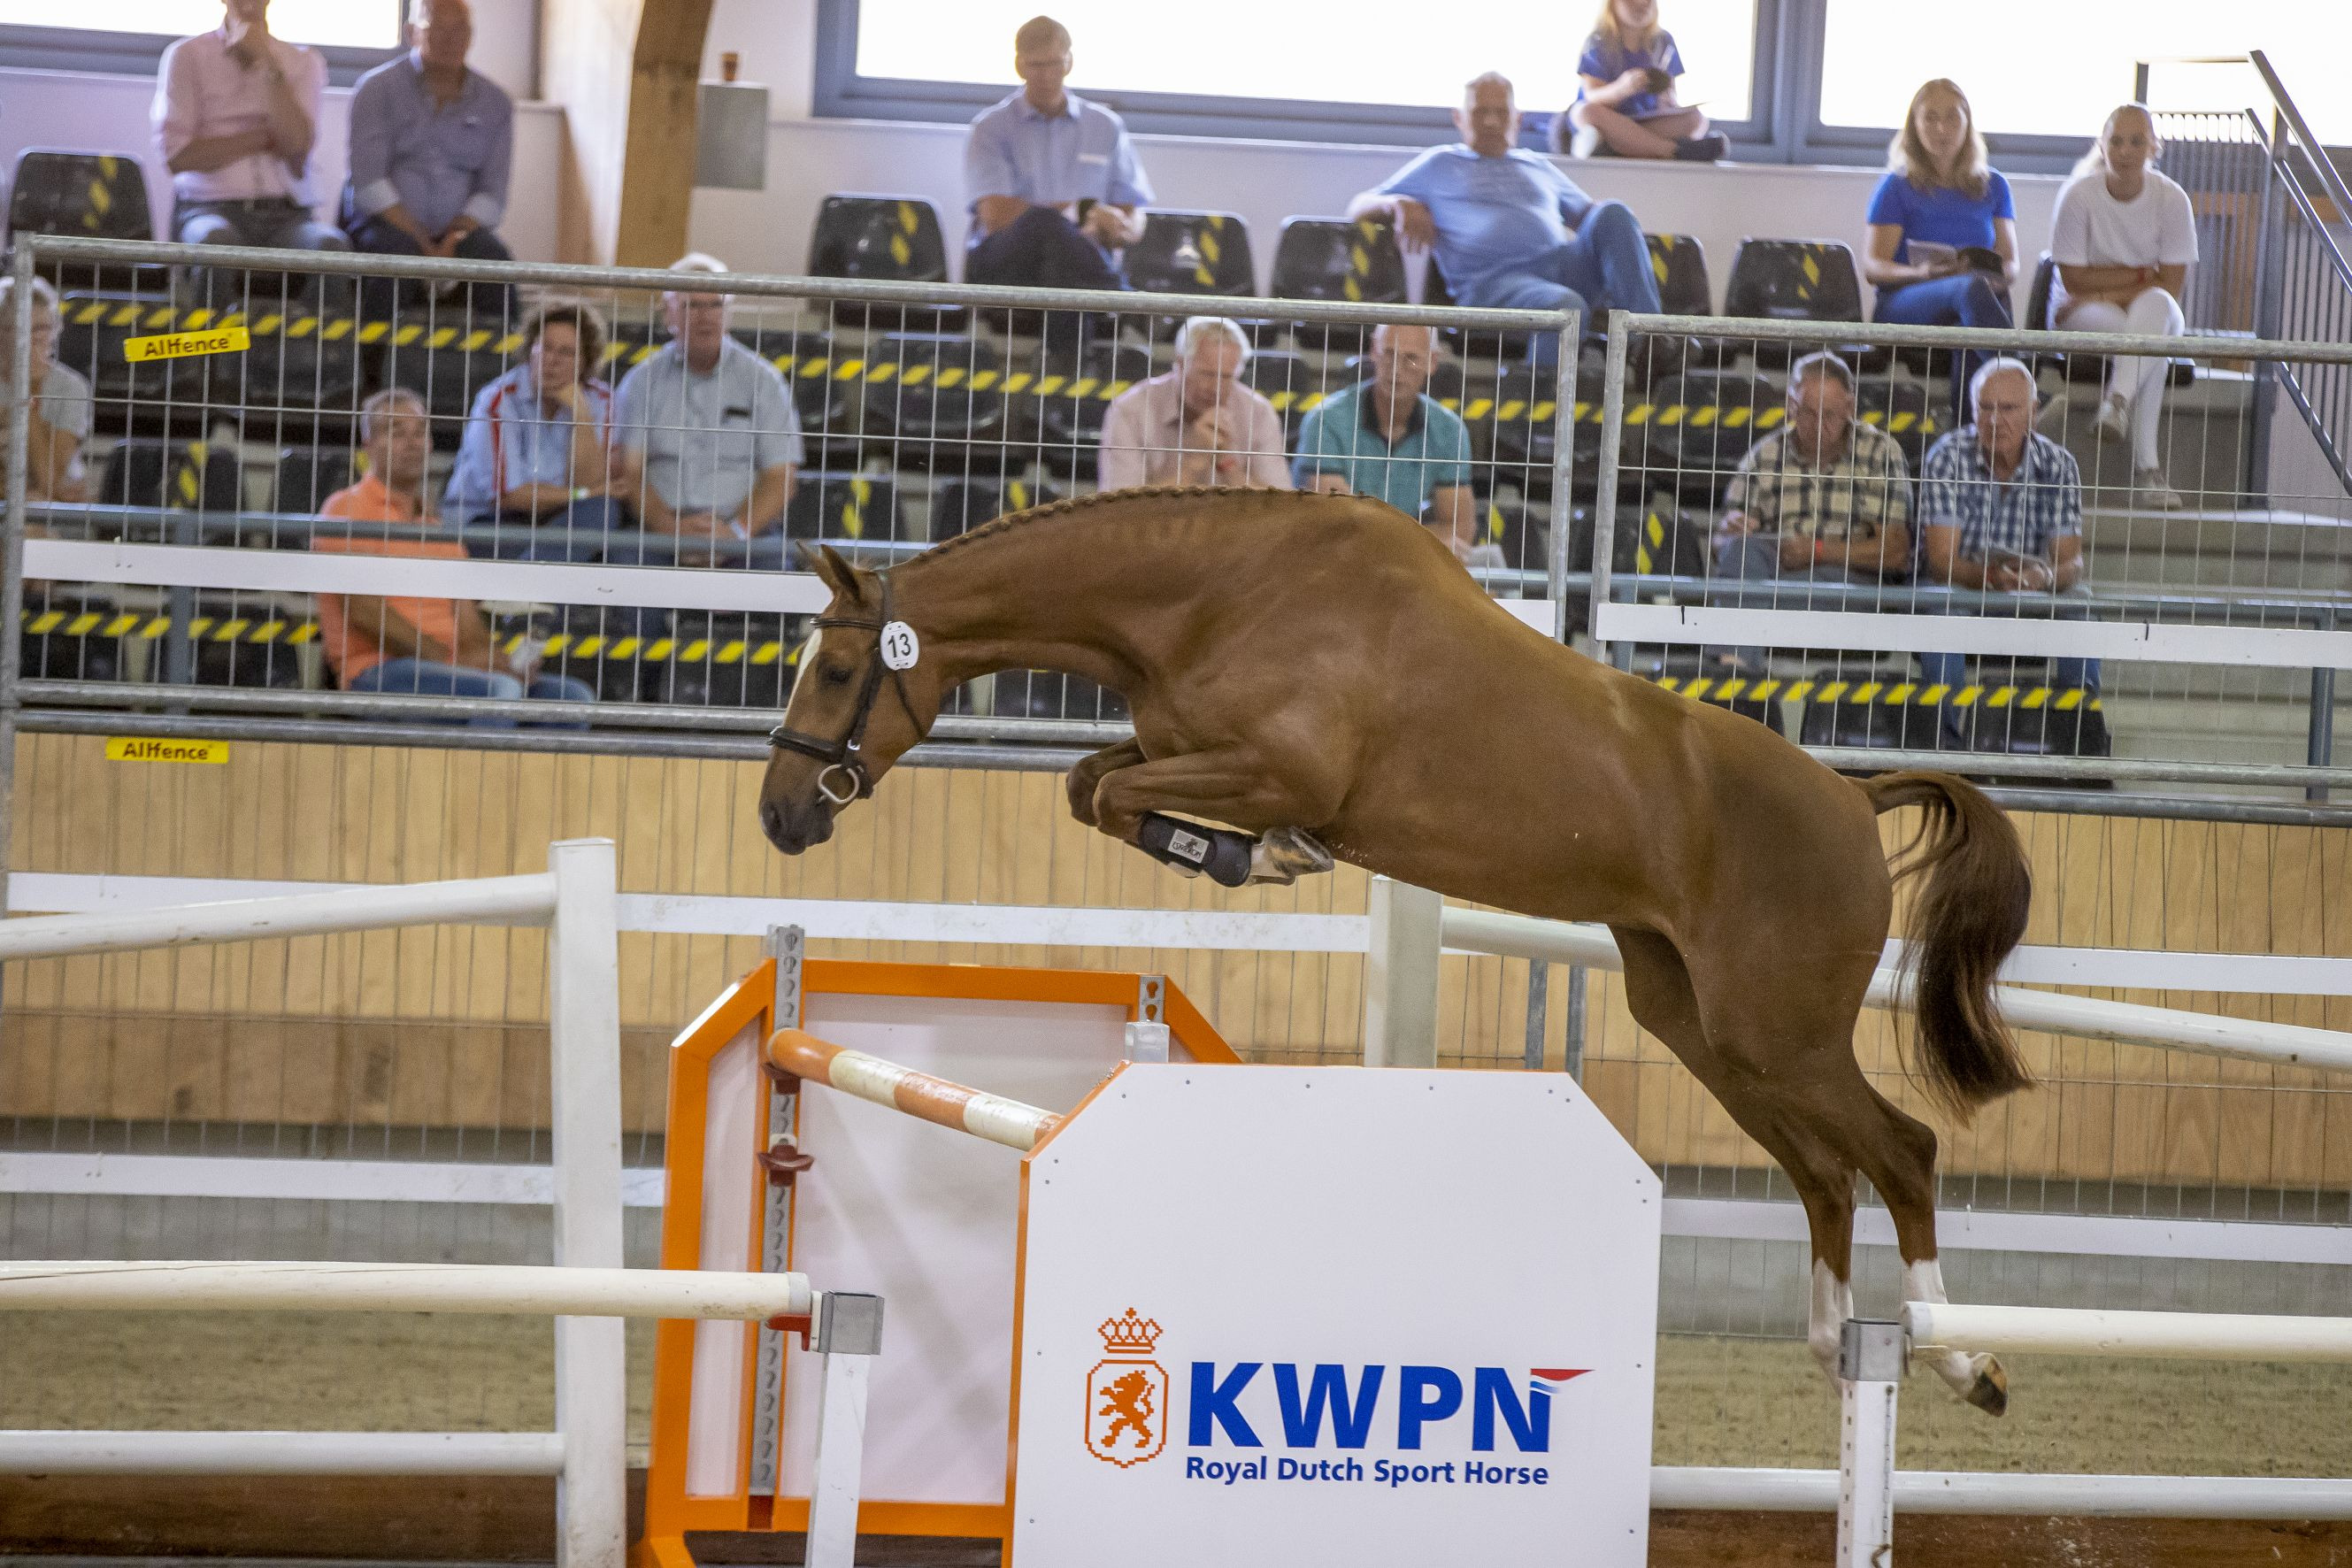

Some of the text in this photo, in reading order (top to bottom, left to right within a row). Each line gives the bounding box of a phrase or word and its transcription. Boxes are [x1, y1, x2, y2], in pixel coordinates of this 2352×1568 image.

[888, 633, 911, 658] 13
[1188, 1361, 1551, 1453] KWPN
[1186, 1456, 1549, 1488] Royal Dutch Sport Horse
